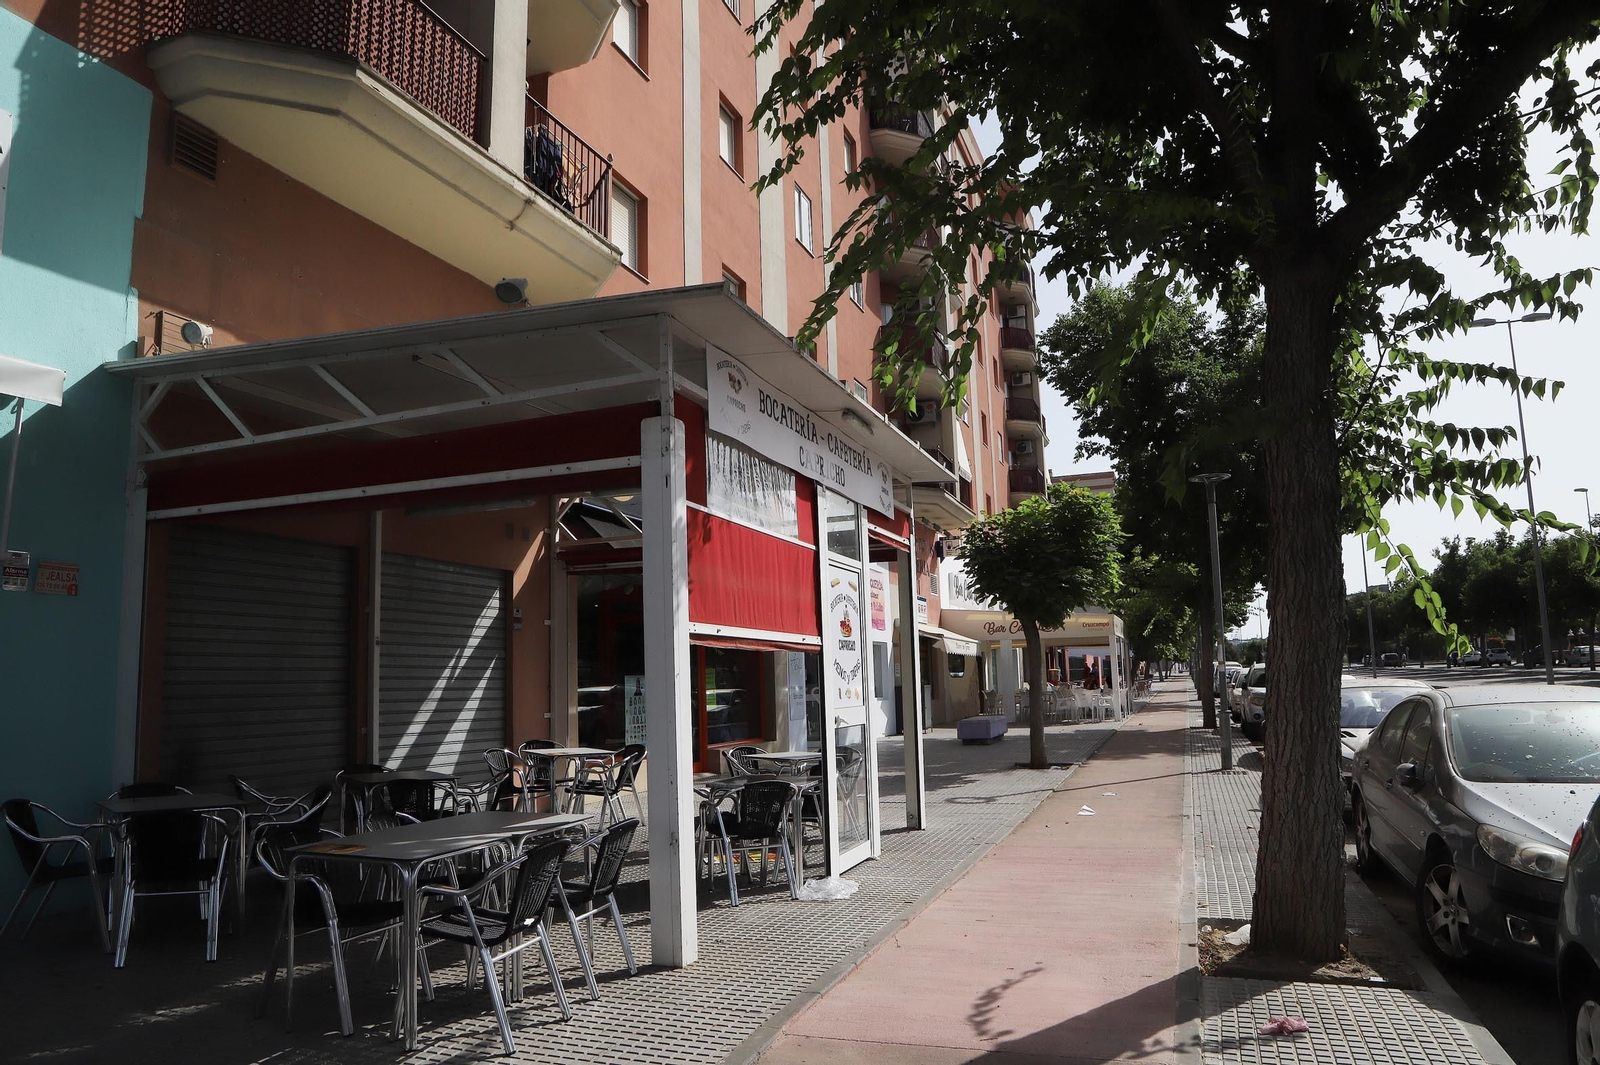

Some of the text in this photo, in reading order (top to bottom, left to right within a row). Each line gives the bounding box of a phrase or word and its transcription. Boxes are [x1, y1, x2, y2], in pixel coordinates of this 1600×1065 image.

[758, 388, 819, 445] BOCATERÍA
[827, 432, 873, 477] CAFETERÍA
[799, 446, 846, 487] CAPRICHO
[983, 621, 1006, 635] Bar
